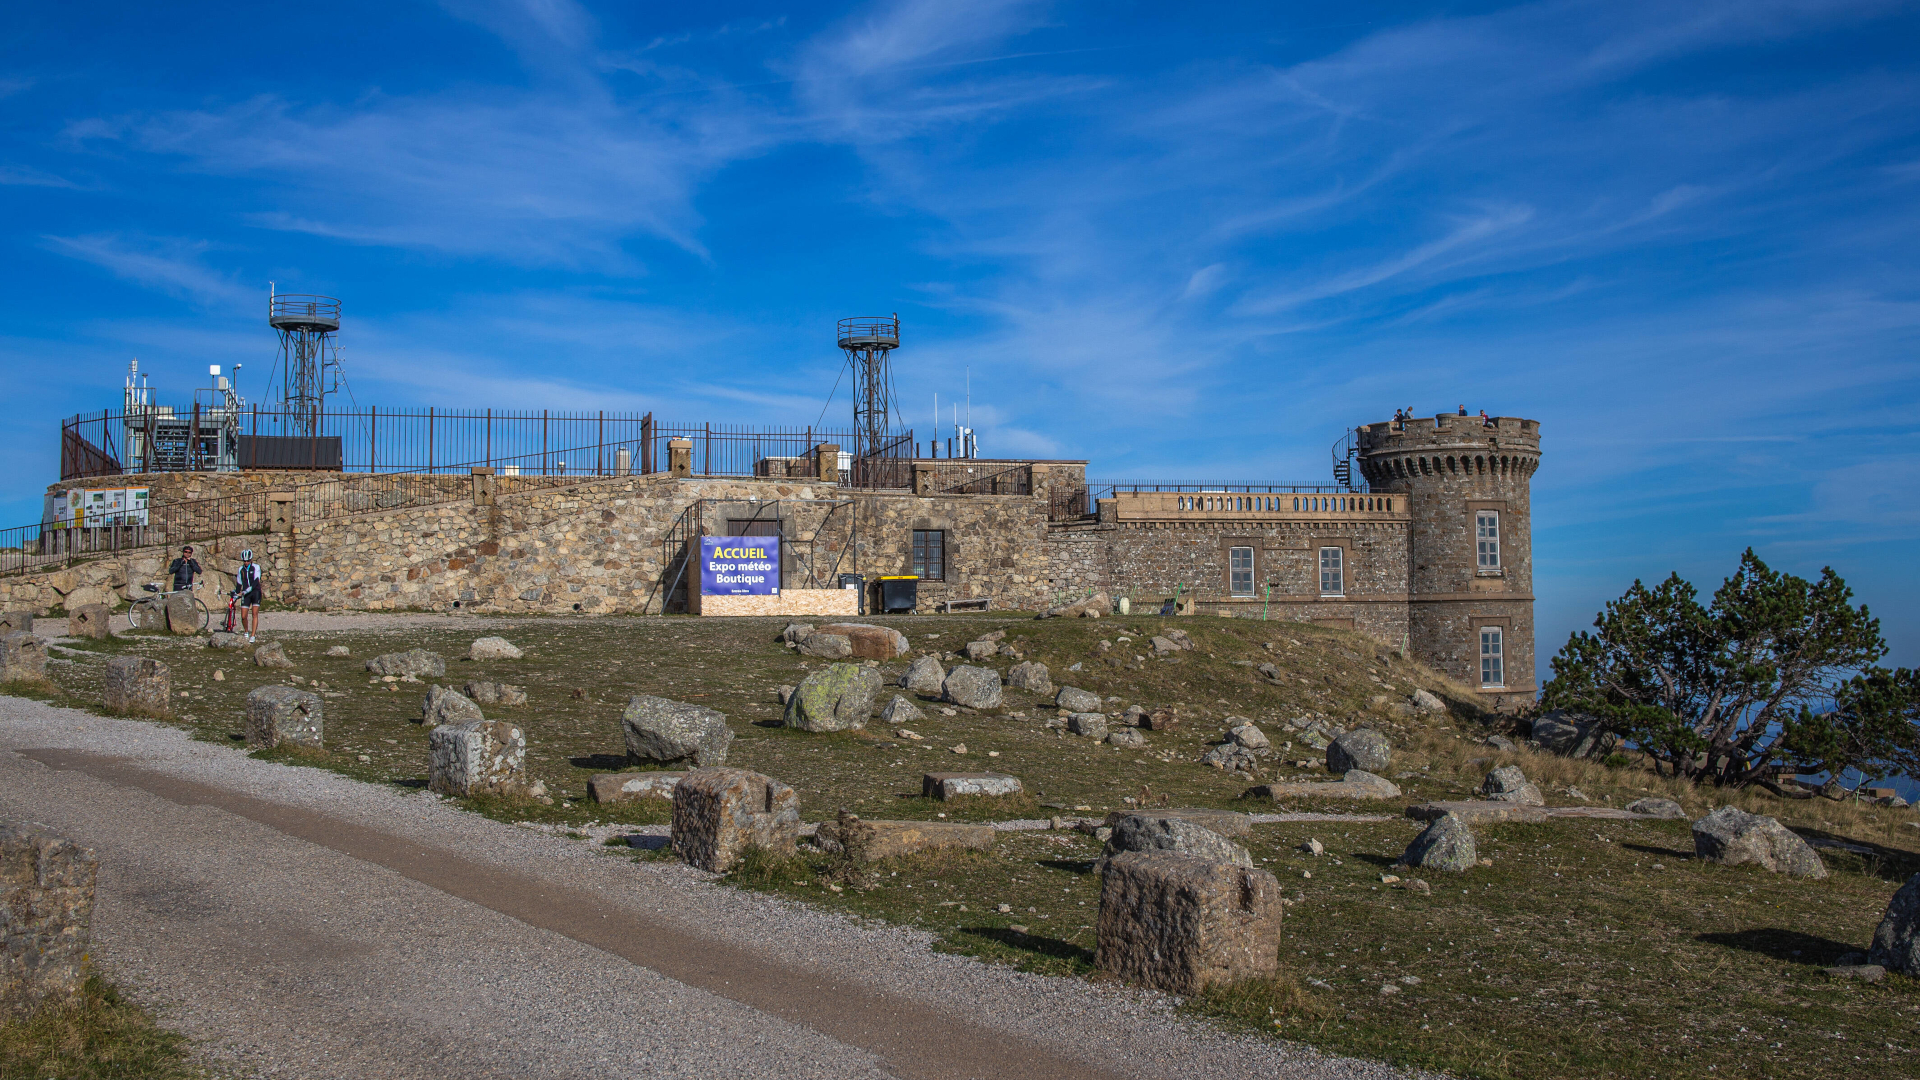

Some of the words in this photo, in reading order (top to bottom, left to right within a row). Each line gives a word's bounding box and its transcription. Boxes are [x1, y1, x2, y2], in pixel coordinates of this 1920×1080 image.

[713, 547, 768, 559] ACCUEIL
[709, 561, 736, 573] Expo
[737, 561, 772, 571] météo
[716, 574, 765, 585] Boutique
